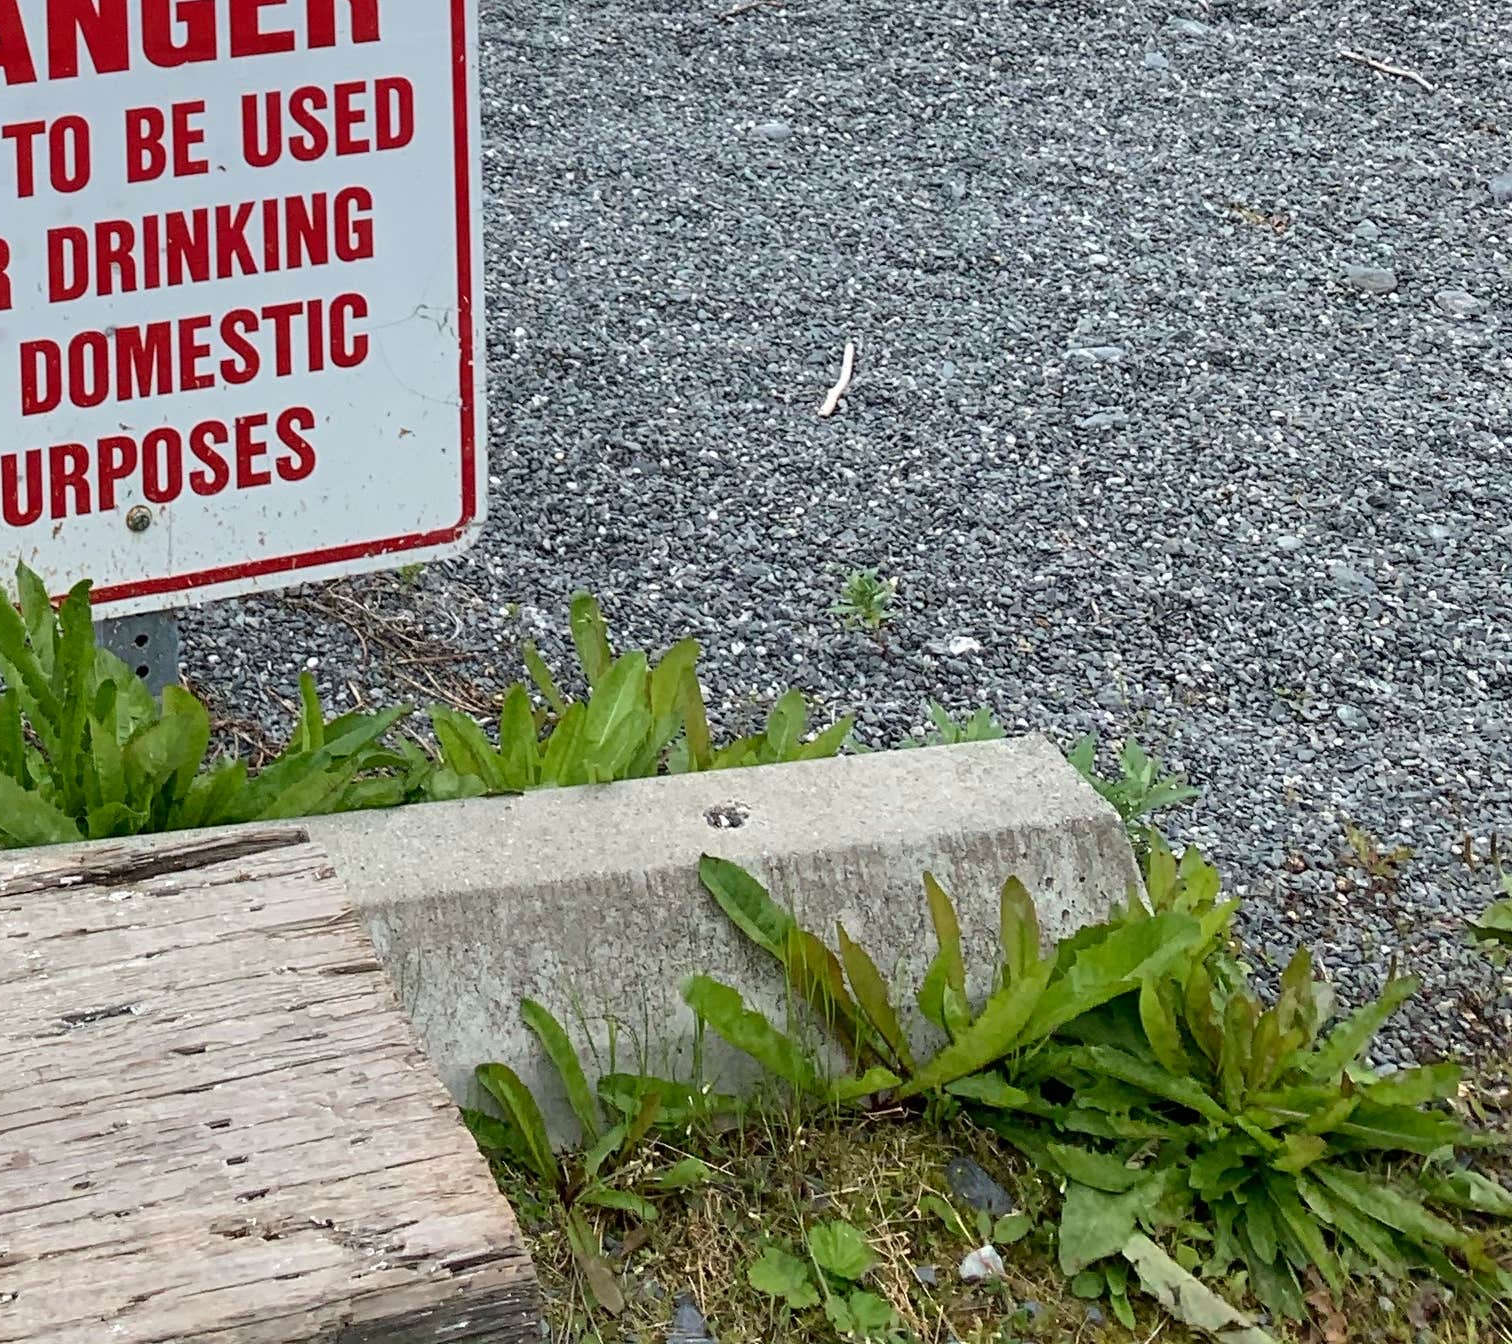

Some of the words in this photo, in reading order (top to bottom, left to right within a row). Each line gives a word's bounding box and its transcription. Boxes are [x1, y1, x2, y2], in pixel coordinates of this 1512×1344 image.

[2, 114, 90, 198] TO
[125, 100, 208, 183] BE
[241, 76, 414, 168] USED
[47, 186, 374, 303] DRINKING
[21, 293, 369, 416] DOMESTIC
